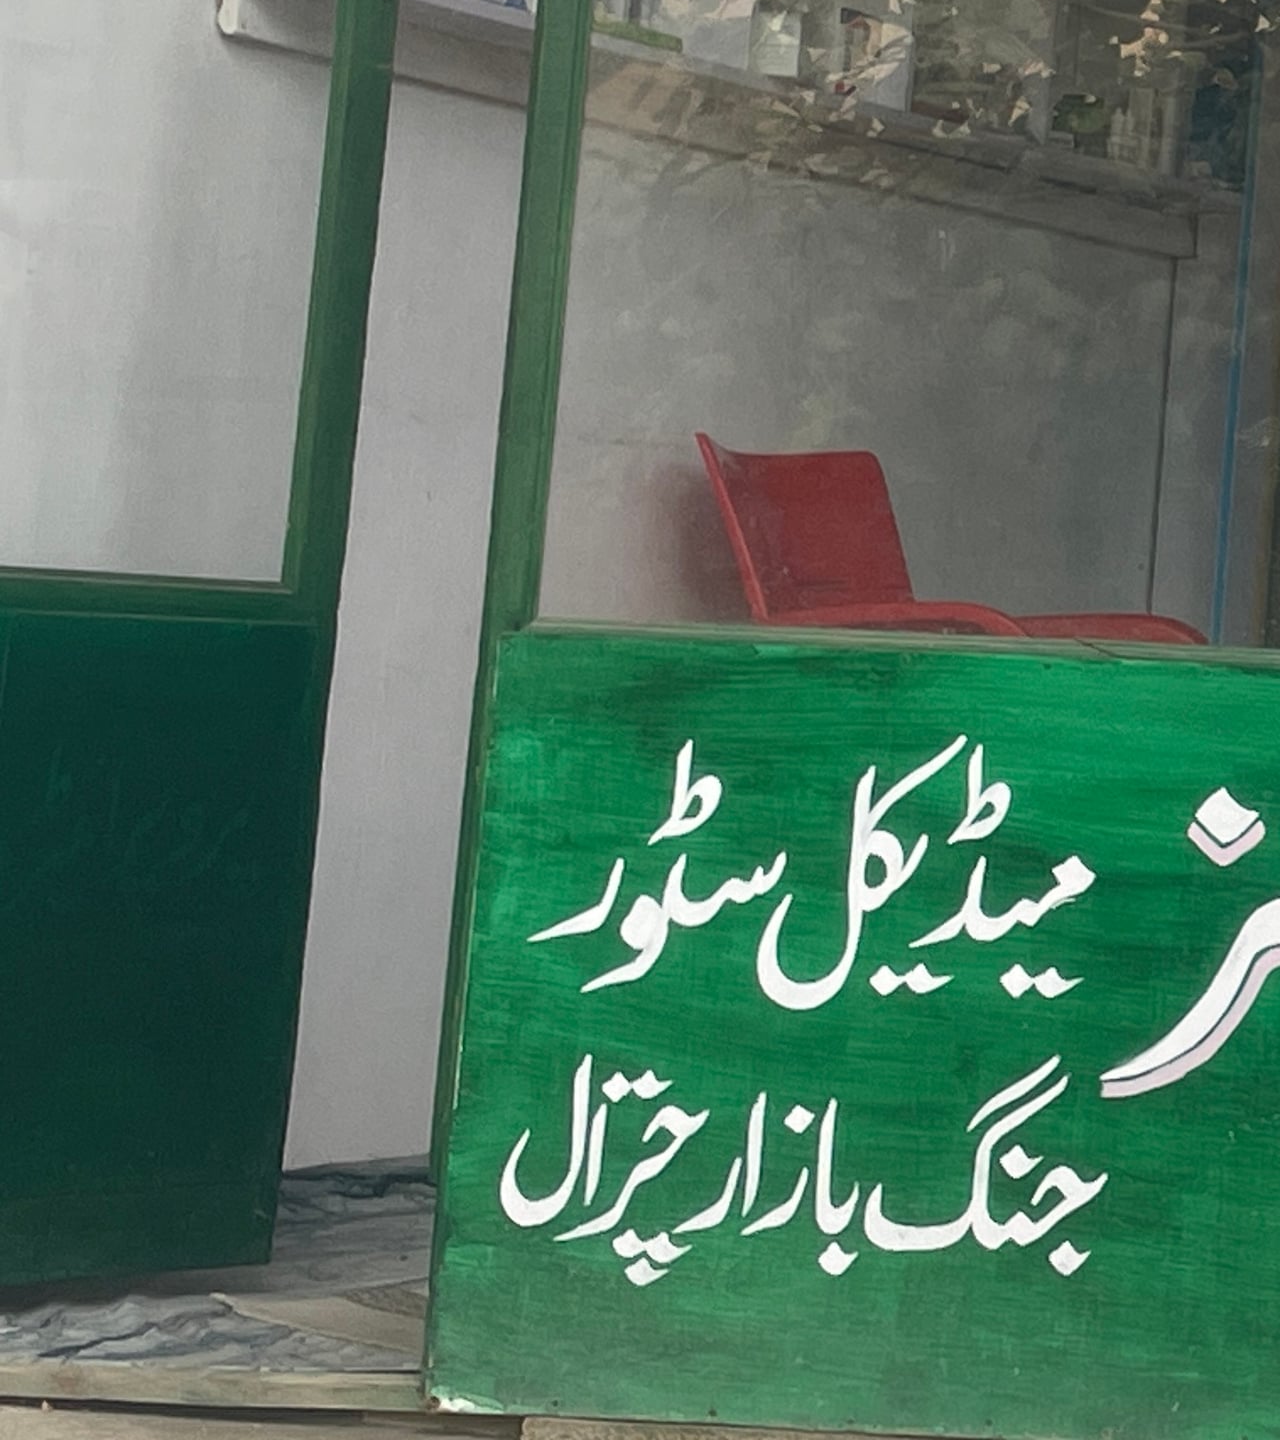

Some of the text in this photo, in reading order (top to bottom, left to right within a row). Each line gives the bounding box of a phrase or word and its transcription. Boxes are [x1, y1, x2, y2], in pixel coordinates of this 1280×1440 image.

[526, 738, 788, 994] سٹور
[756, 734, 1098, 1011] میڈیکل
[499, 1053, 1109, 1287] جنگ بازار چترال
